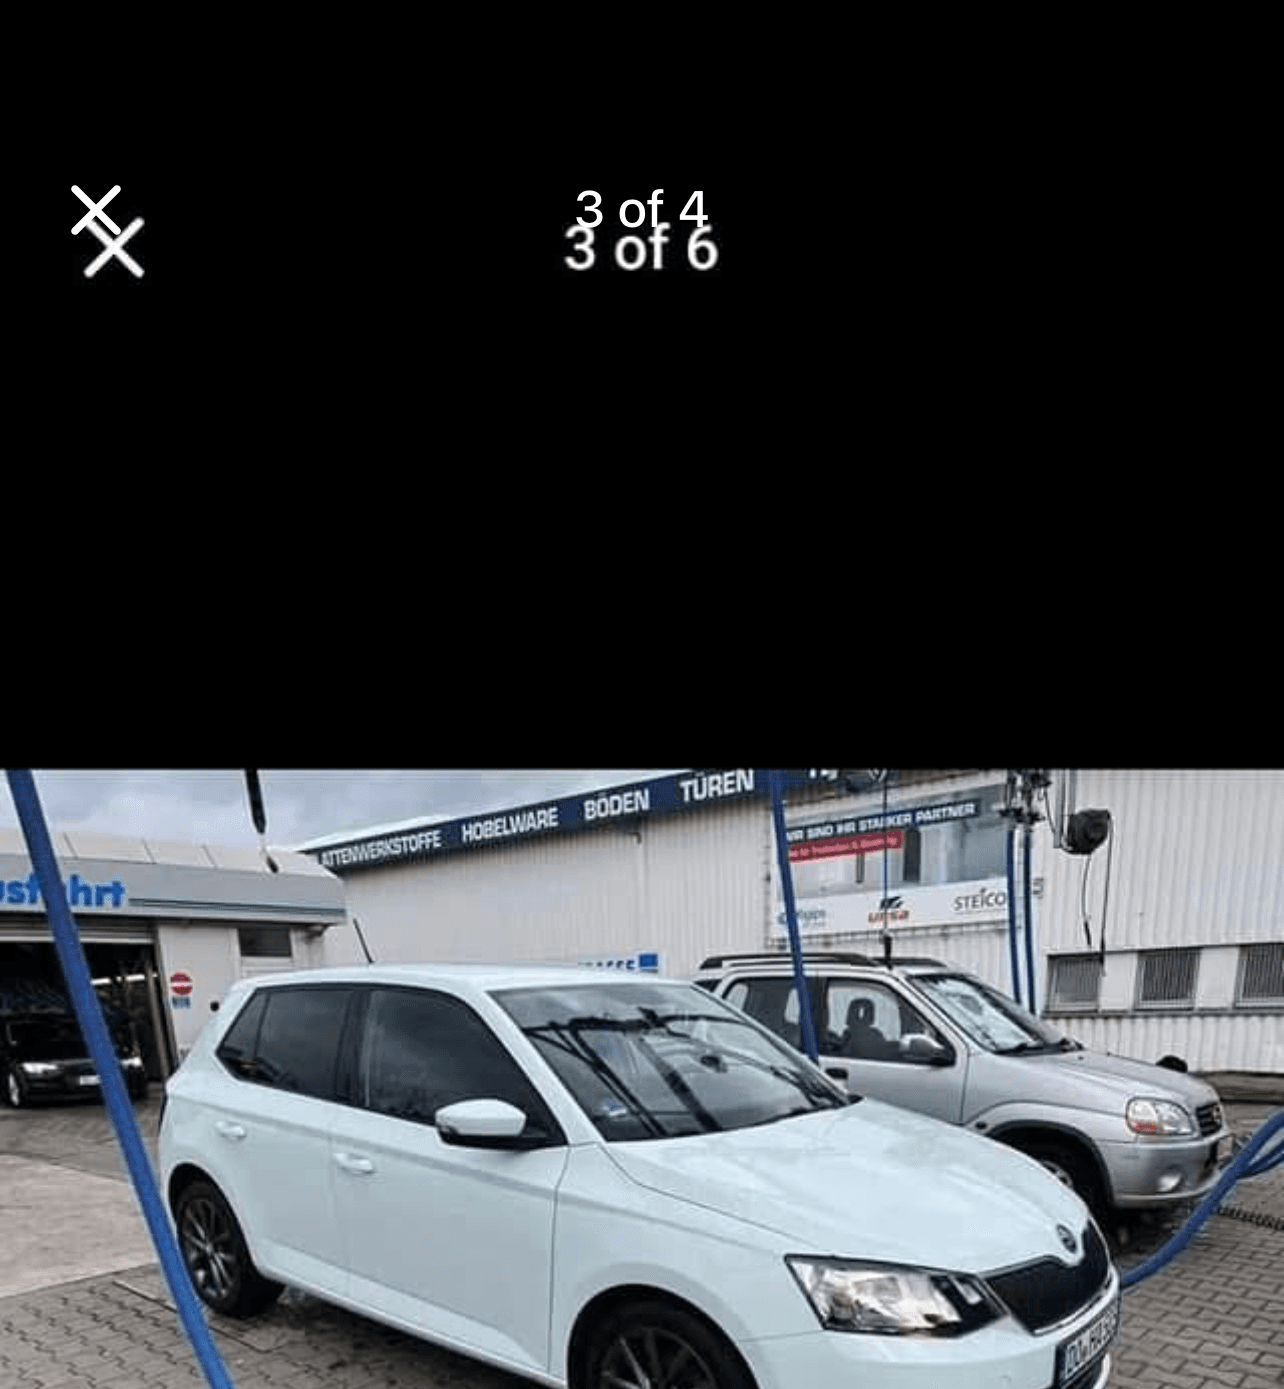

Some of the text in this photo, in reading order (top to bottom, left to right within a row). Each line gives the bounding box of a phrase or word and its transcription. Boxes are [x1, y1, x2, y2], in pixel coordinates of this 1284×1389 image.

[461, 807, 559, 843] HOBELWARE
[584, 788, 650, 822] BÖDEN
[679, 768, 754, 802] TÜREN
[915, 803, 976, 825] PARTNER
